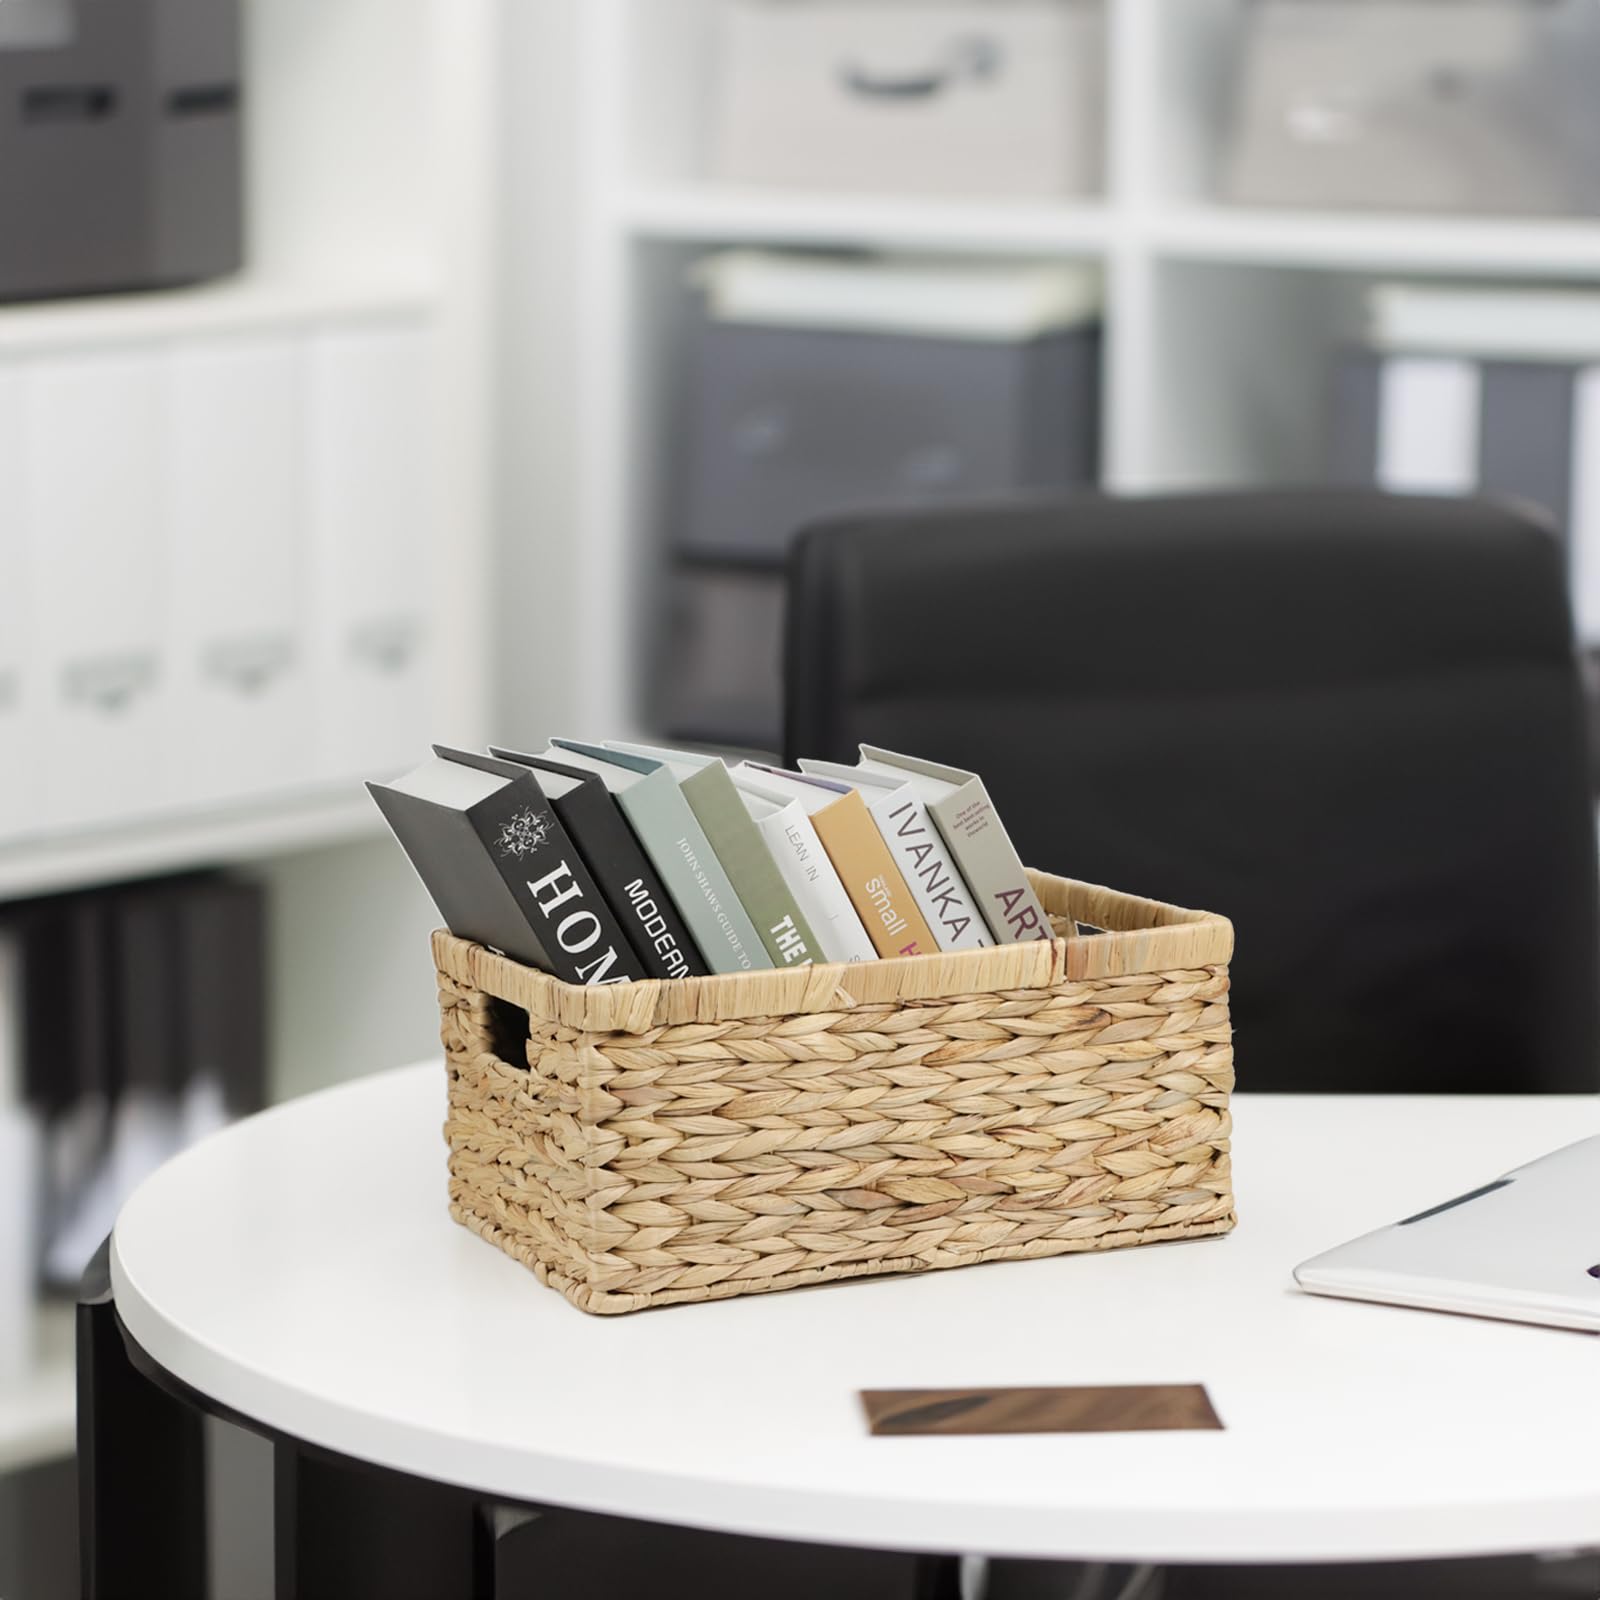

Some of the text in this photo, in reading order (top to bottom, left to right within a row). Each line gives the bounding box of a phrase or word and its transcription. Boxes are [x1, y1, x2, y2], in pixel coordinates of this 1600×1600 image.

[785, 825, 820, 882] LEAN IN
[889, 802, 971, 942] IVANKA
[624, 878, 690, 980] MODERN
[677, 837, 752, 970] JOHN SHAWS GUIDE TO
[865, 878, 908, 936] small
[994, 888, 1048, 940] ART
[770, 914, 807, 963] THE
